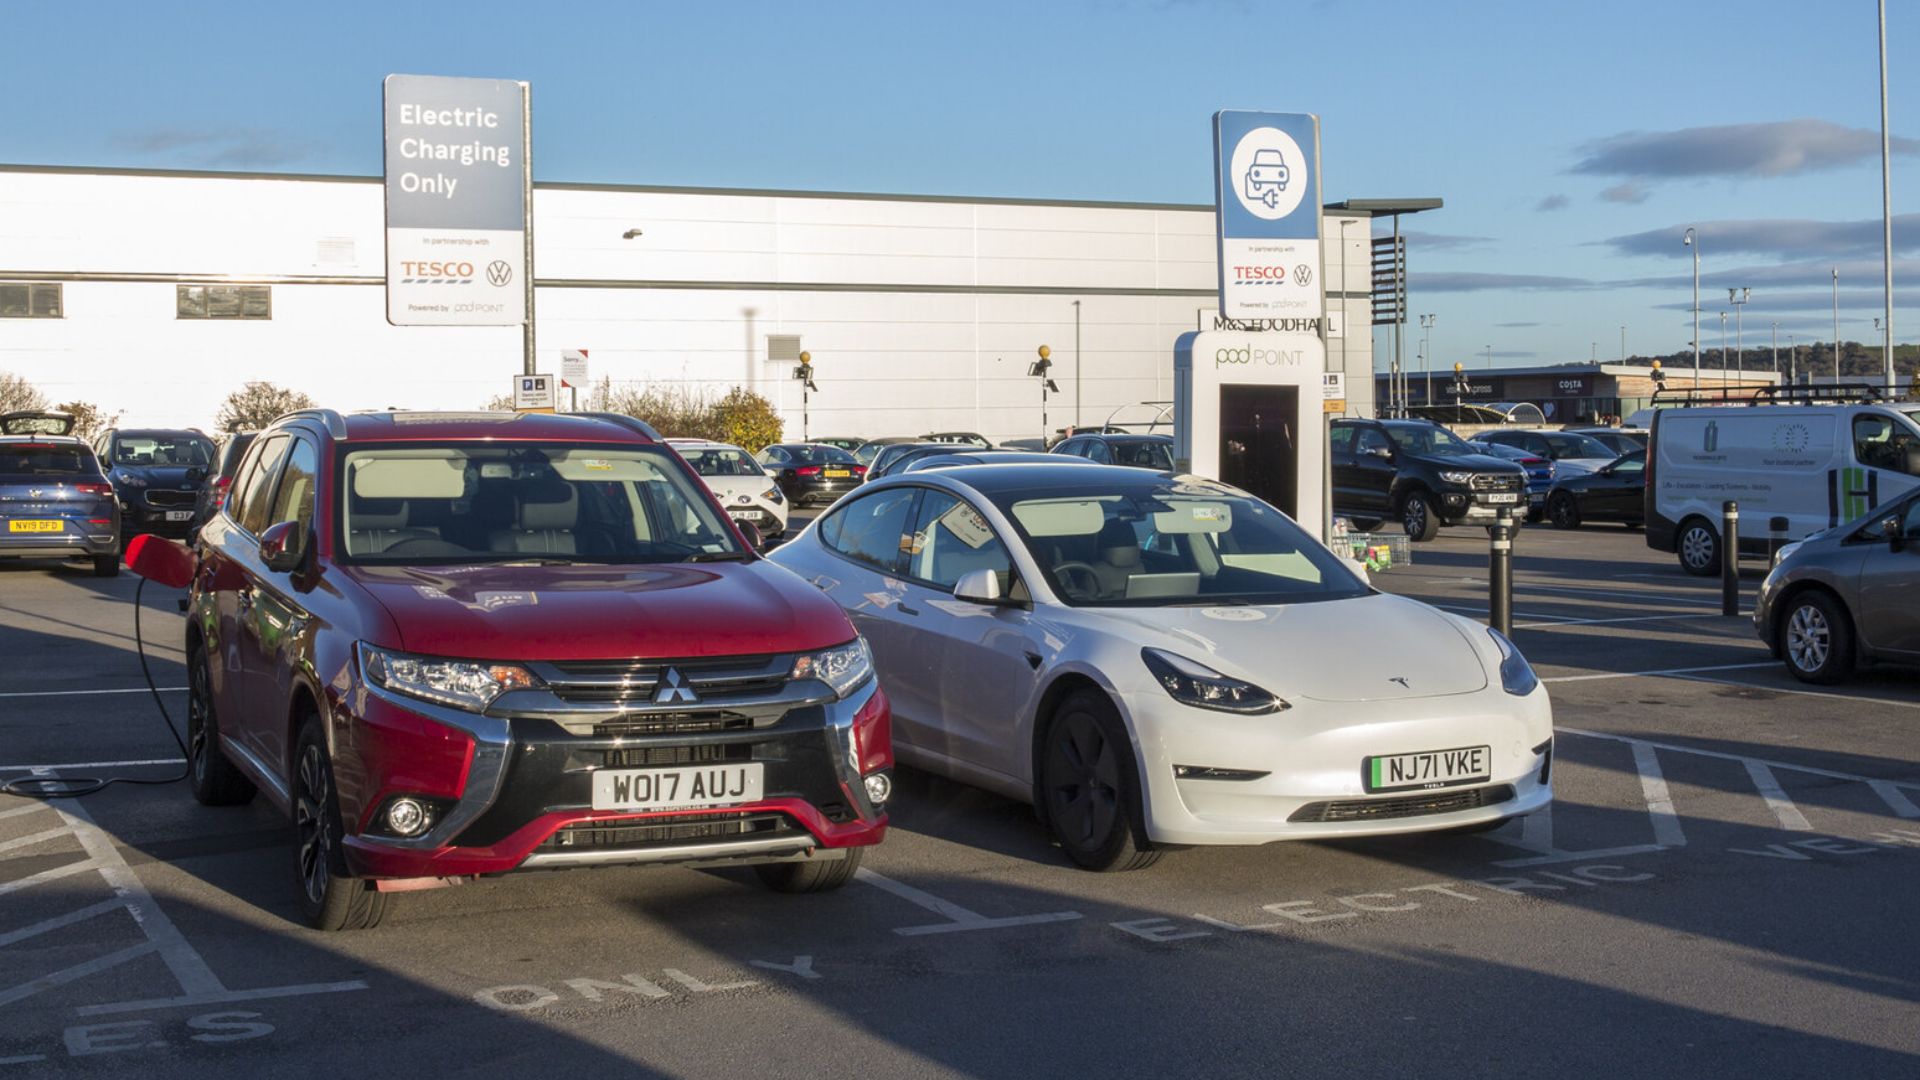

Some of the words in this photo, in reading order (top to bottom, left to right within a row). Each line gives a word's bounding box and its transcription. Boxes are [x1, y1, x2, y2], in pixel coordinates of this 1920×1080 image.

[400, 104, 498, 128] Electric
[400, 138, 510, 167] Charging
[400, 172, 458, 199] Only
[431, 238, 473, 246] partnership
[401, 261, 474, 277] TESCO
[1233, 266, 1285, 279] TESCO
[440, 304, 449, 312] by
[1213, 316, 1246, 331] M&S
[1216, 343, 1250, 370] pod
[1254, 350, 1304, 366] POINT
[1559, 380, 1583, 389] COSTA
[15, 522, 37, 530] NV19
[39, 522, 58, 530] DFD
[1390, 754, 1438, 782] NJ71
[1444, 750, 1482, 776] VKE
[613, 772, 680, 803] WO17
[690, 768, 746, 800] AUJ
[1109, 864, 1655, 942] ELECTRIC
[473, 955, 822, 1011] ONLY
